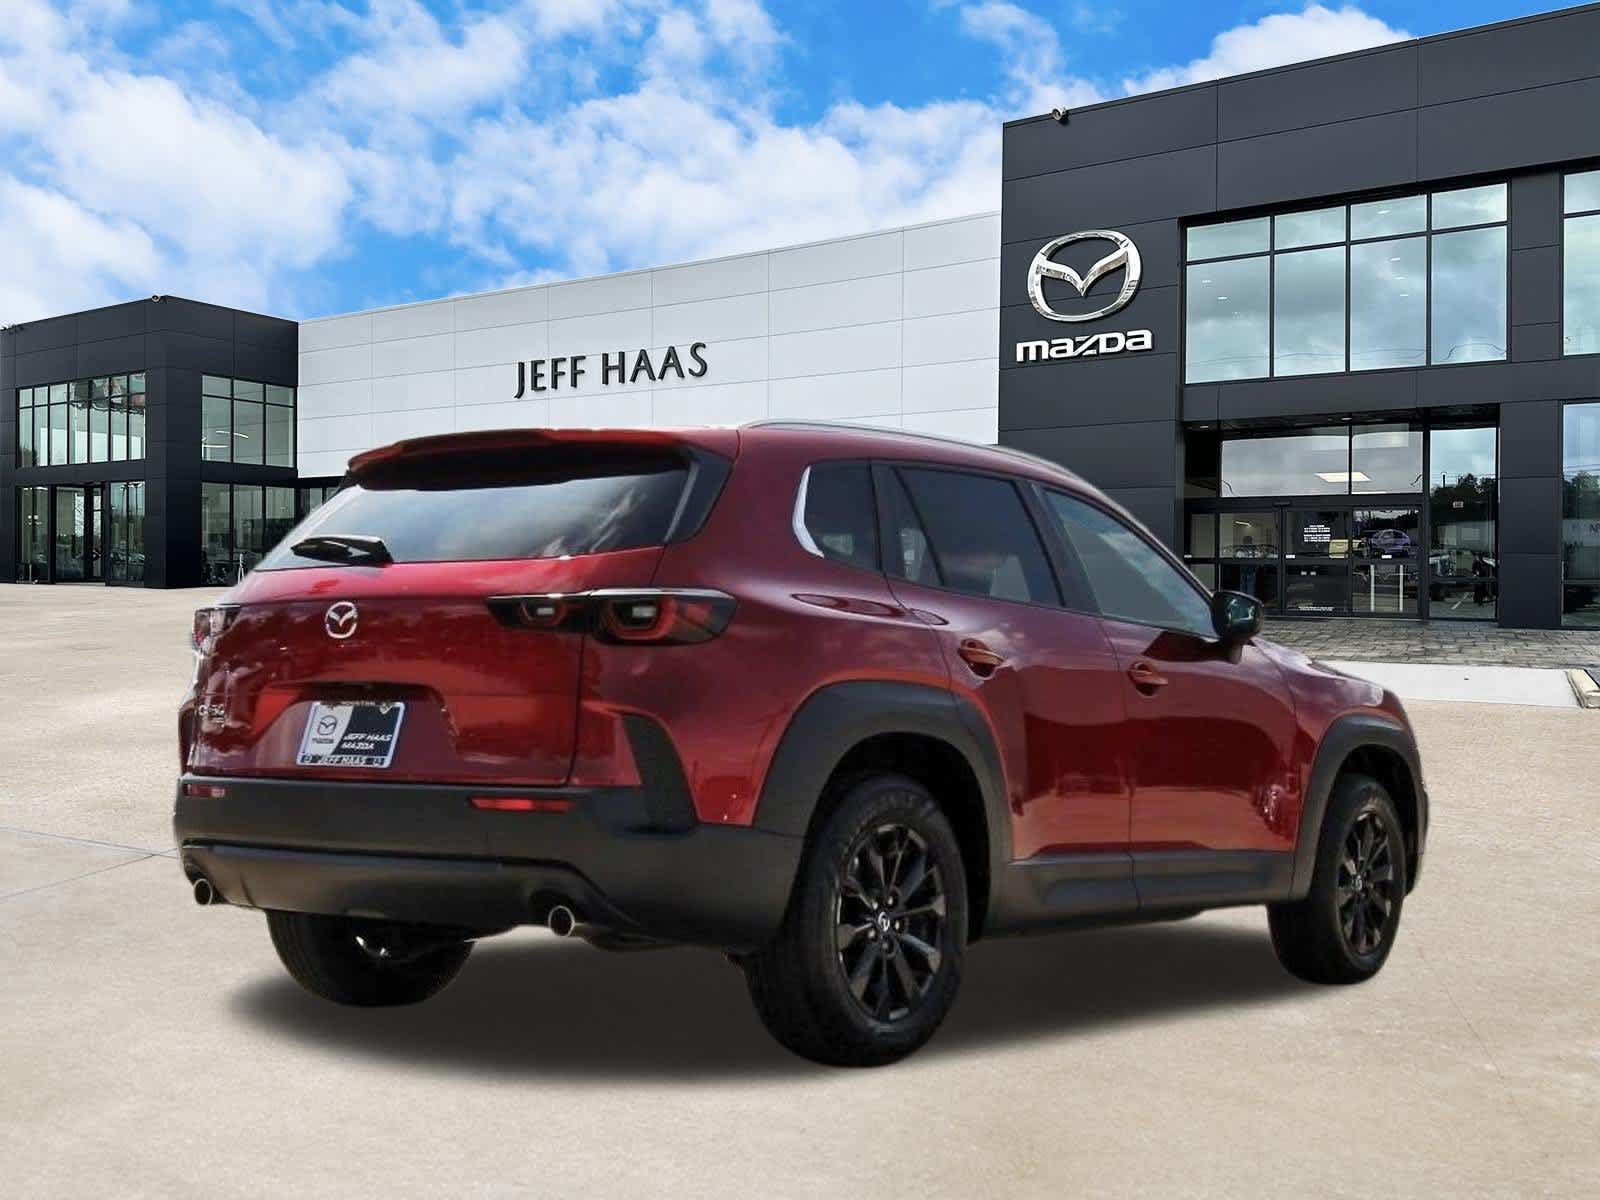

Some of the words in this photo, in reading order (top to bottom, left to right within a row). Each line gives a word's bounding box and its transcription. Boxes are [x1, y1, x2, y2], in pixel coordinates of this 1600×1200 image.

[513, 355, 587, 399] JEFF
[601, 342, 708, 386] HAAS
[343, 732, 368, 741] JEFF
[366, 733, 393, 742] HAAS
[341, 741, 375, 750] MAZDA
